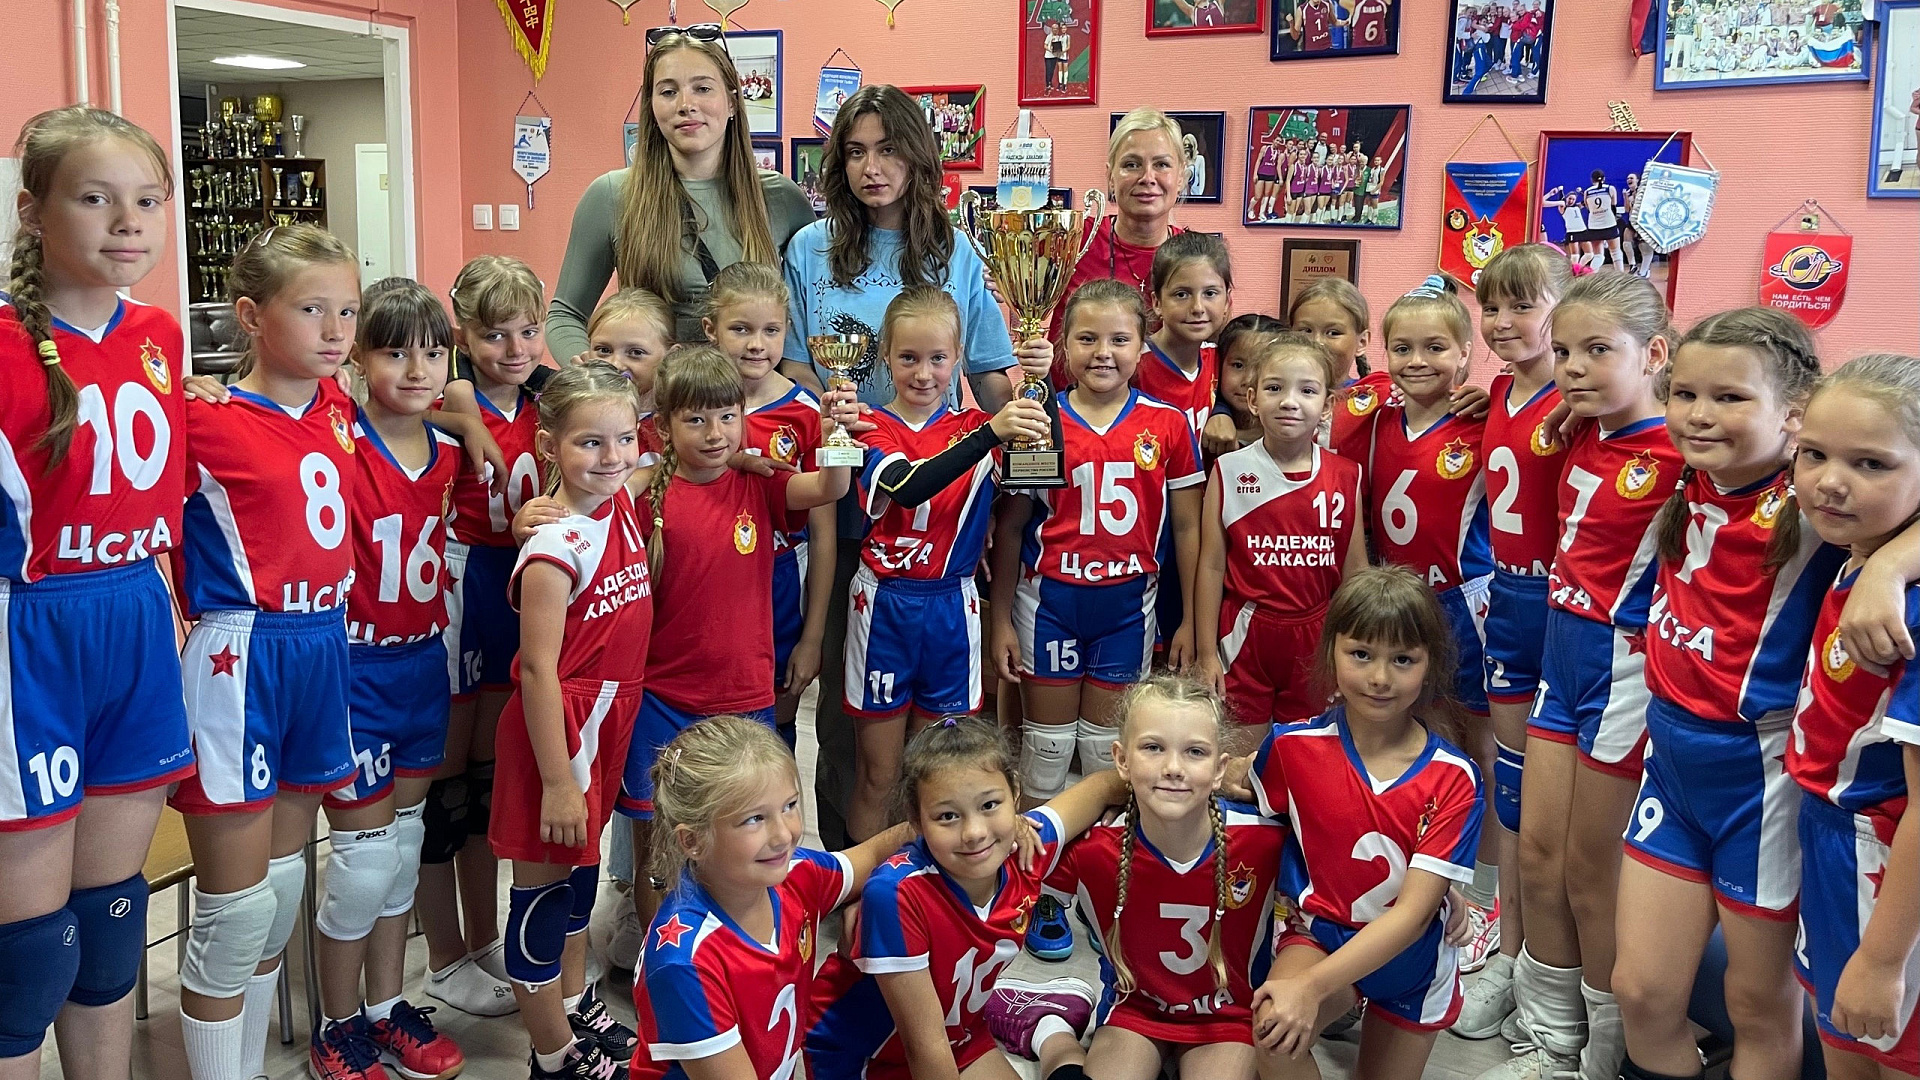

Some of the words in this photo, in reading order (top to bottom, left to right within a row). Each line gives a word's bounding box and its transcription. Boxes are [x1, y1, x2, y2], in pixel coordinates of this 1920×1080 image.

[1364, 20, 1379, 41] 6
[1594, 197, 1602, 209] 9
[1770, 299, 1831, 310] ГОРДИТЬСЯ!
[1792, 294, 1811, 302] ЕСТЬ
[1815, 295, 1831, 303] ЧЕМ
[77, 381, 172, 496] 10
[300, 452, 346, 550] 8
[1072, 461, 1138, 536] 15
[1236, 484, 1261, 494] errea
[1312, 491, 1345, 529] 12
[1381, 469, 1418, 546] 6
[1488, 446, 1523, 535] 2
[1560, 464, 1604, 553] 7
[57, 516, 173, 564] ЦСКА
[372, 513, 442, 603] 16
[1060, 552, 1143, 582] ЦСКА
[1046, 639, 1080, 672] 15
[1486, 655, 1511, 687] 2
[869, 671, 895, 704] 11
[29, 745, 79, 806] 10
[159, 747, 190, 765] surus
[251, 743, 271, 790] 8
[358, 742, 392, 787] 16
[1634, 797, 1664, 842] 9
[1351, 831, 1407, 923] 2
[1159, 903, 1210, 975] 3
[944, 939, 1020, 1027] 10
[766, 983, 799, 1080] 2
